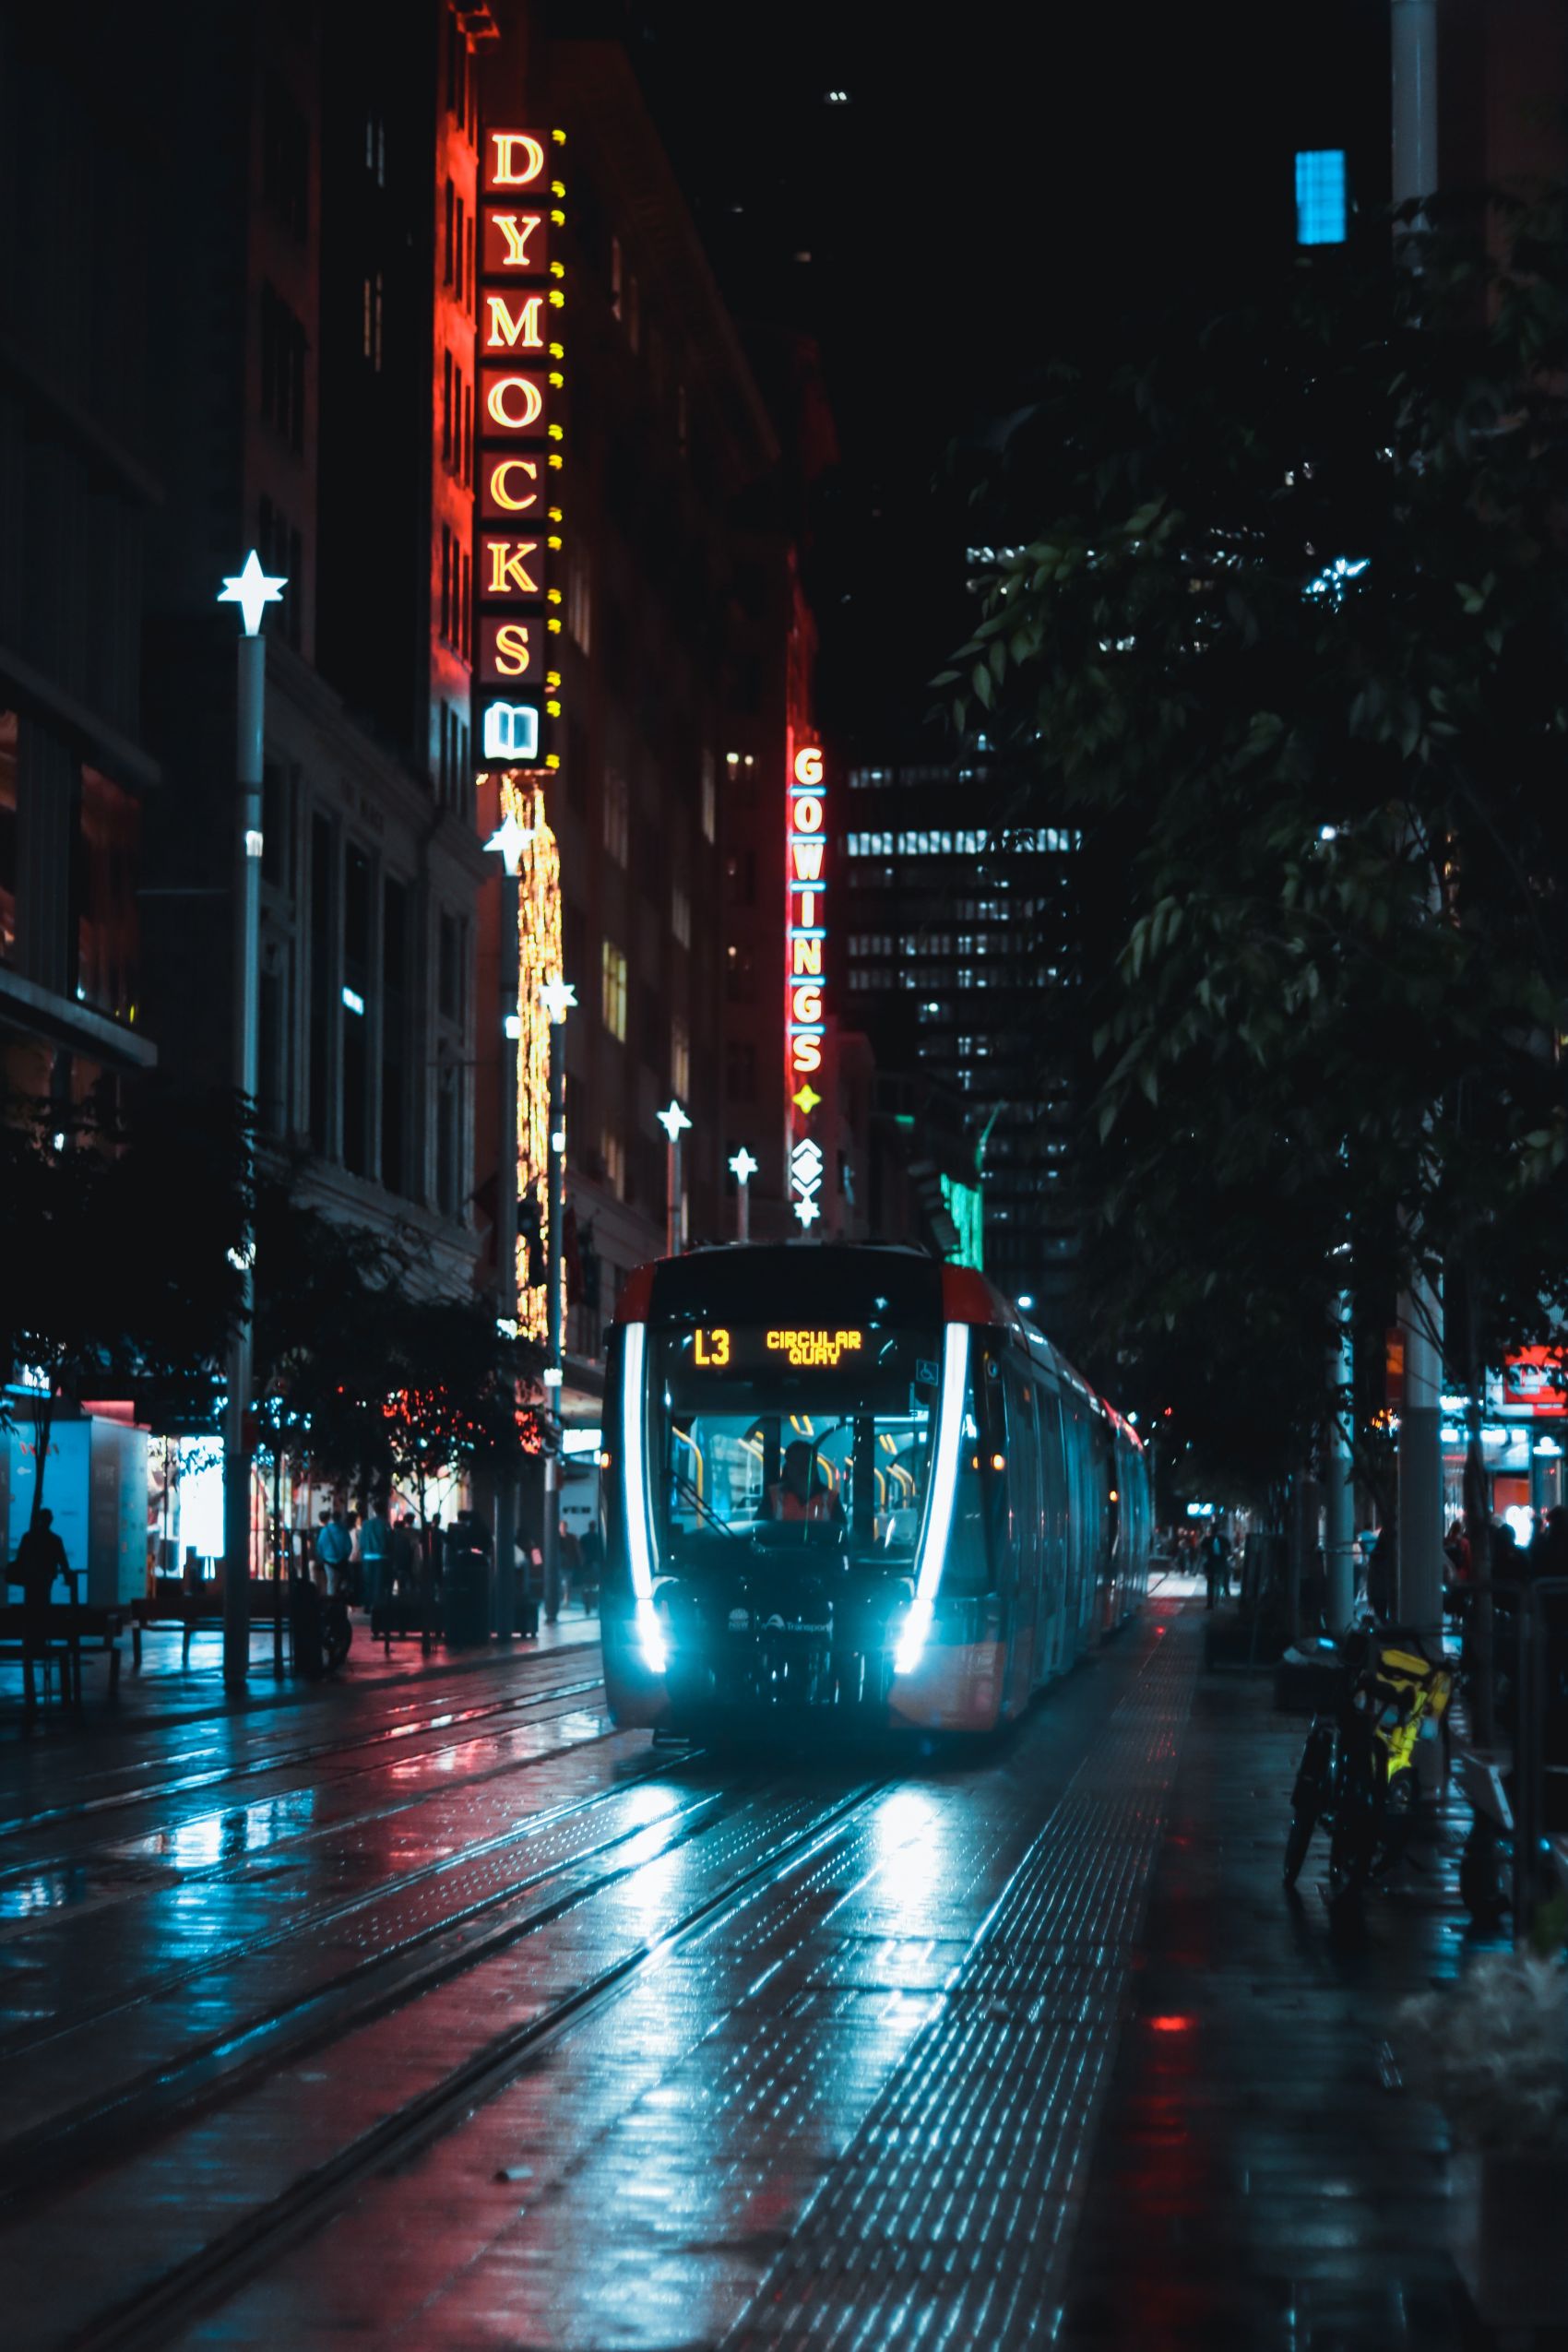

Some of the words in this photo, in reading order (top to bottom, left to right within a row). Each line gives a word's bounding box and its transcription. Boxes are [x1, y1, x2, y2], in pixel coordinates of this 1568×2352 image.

[486, 133, 545, 676] DYMOCKS
[792, 747, 824, 1072] GOWINGS
[695, 1329, 730, 1365] L3
[766, 1331, 861, 1349] CIRCULAR
[789, 1347, 841, 1365] QUAY
[787, 1621, 837, 1633] Transpor
